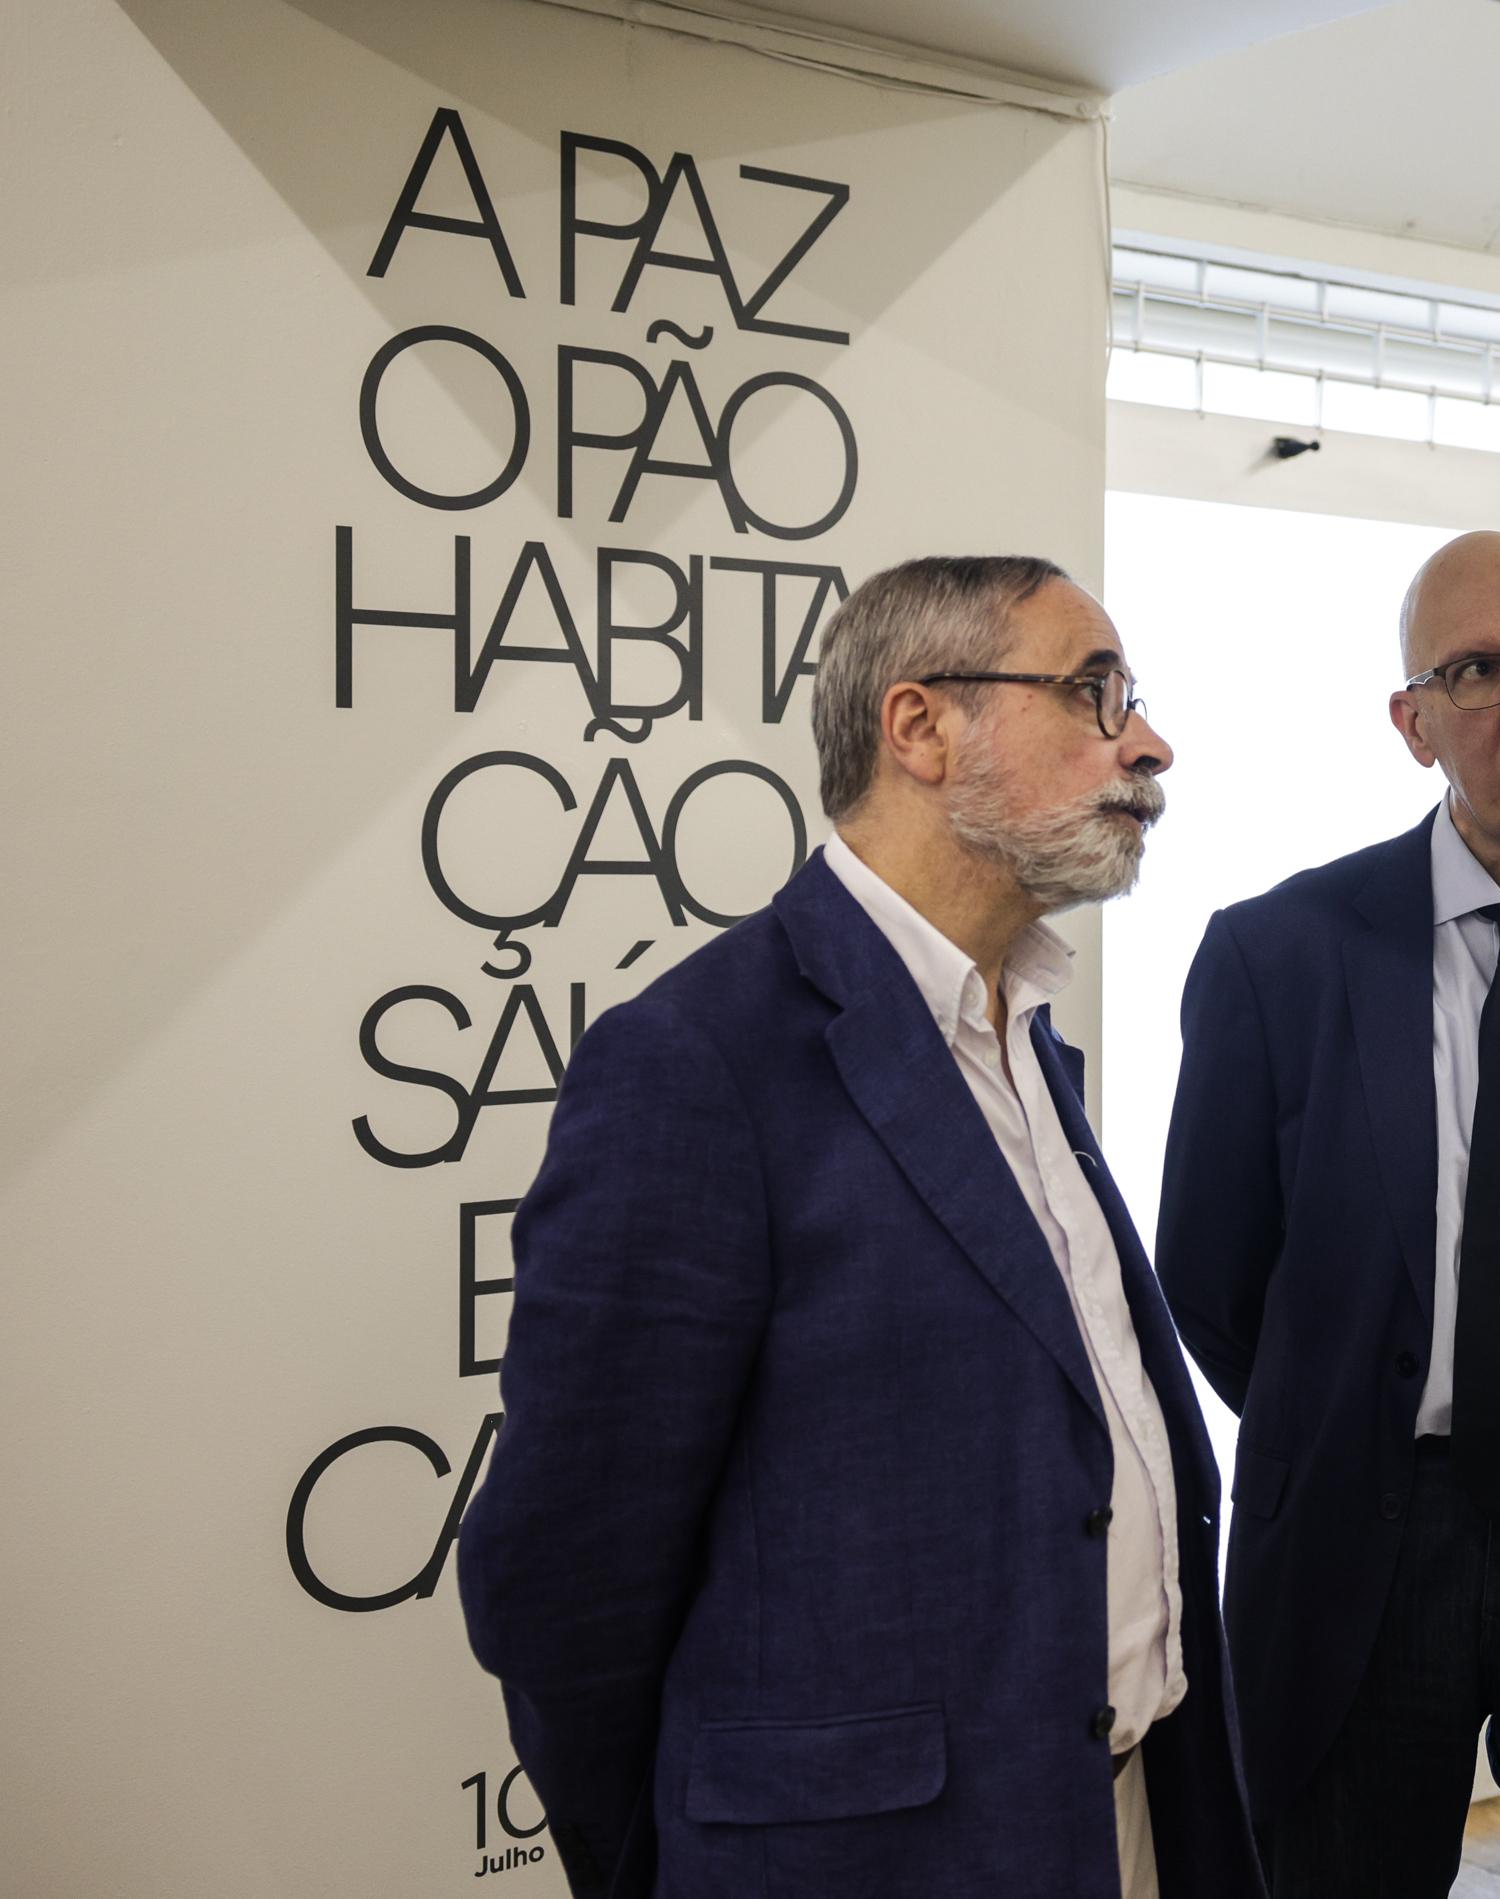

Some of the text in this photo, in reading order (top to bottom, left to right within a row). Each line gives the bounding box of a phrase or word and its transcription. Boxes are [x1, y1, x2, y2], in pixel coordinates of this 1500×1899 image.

[366, 107, 850, 345] A PAZ
[359, 318, 858, 541] O PÃO
[421, 717, 807, 979] ÇÃO
[474, 1846, 545, 1878] Julho
